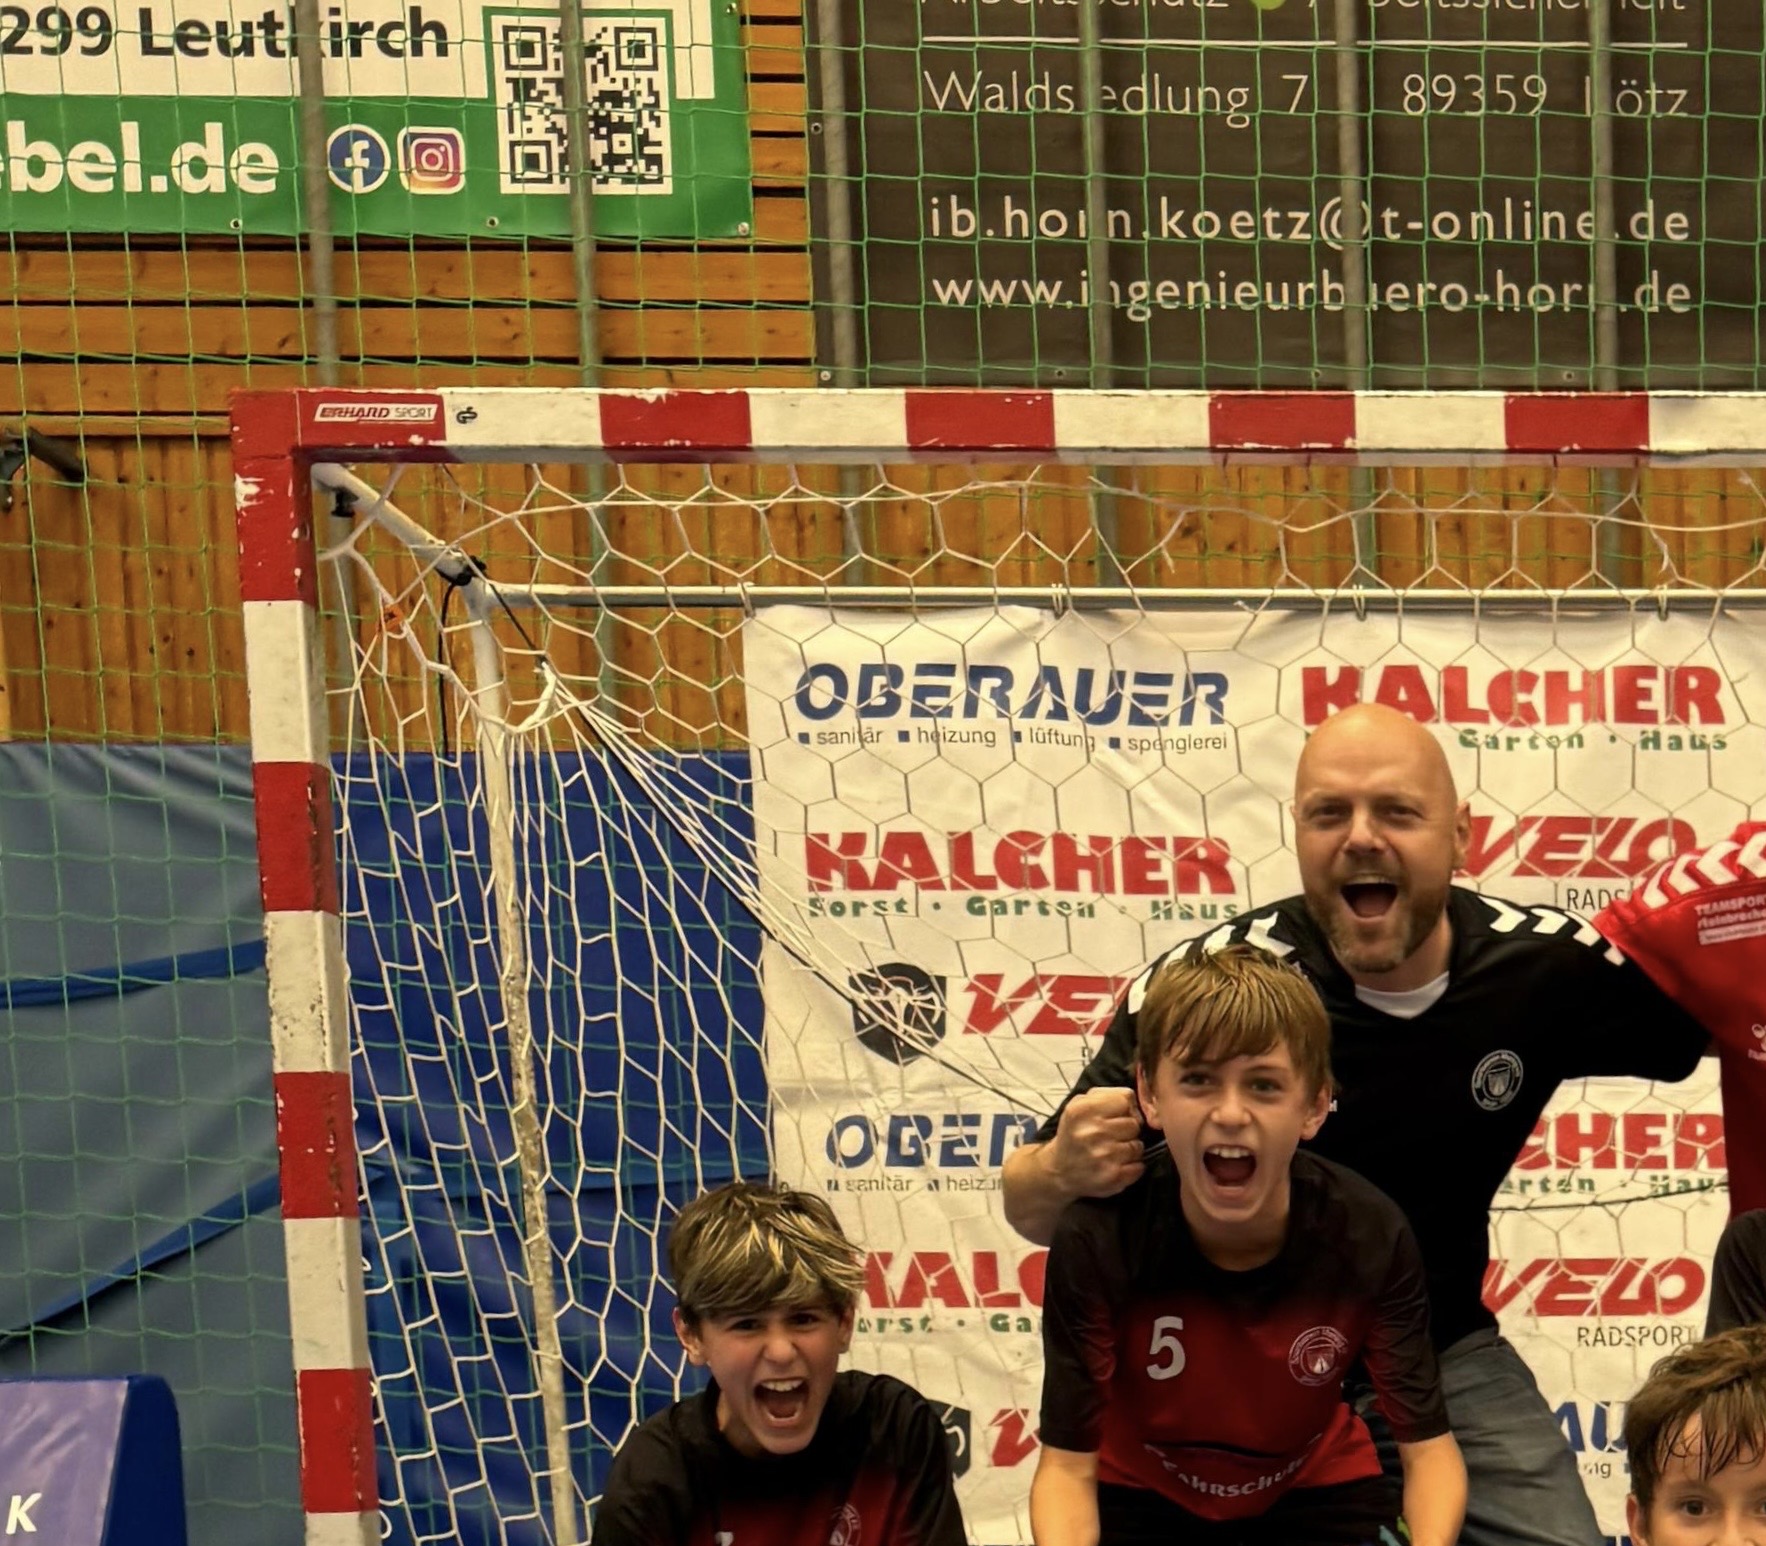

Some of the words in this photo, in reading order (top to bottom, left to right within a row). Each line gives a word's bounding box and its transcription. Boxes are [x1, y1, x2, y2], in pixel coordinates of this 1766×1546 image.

[923, 70, 1250, 129] Waldsedlung
[1281, 74, 1309, 114] 7
[1403, 73, 1547, 117] 89359
[0, 120, 280, 194] bel.de
[395, 406, 431, 418] SPORT
[794, 663, 1230, 727] OBERAUER
[1302, 665, 1726, 727] KALCHER
[816, 728, 883, 746] sanitär
[917, 728, 996, 749] heizung
[1029, 728, 1096, 753] lüftung
[1127, 733, 1228, 755] spenglerei
[1458, 729, 1585, 752] Garten
[1640, 730, 1728, 752] Haus
[804, 831, 1236, 895] KALCHER
[1458, 816, 1698, 878] VELO
[810, 896, 909, 919] Forst
[966, 896, 1096, 919] Garten
[1150, 898, 1239, 921] Haus
[962, 973, 1134, 1036] VE
[1480, 1257, 1706, 1317] VELO
[1146, 1315, 1187, 1381] 5
[6, 1492, 42, 1535] K
